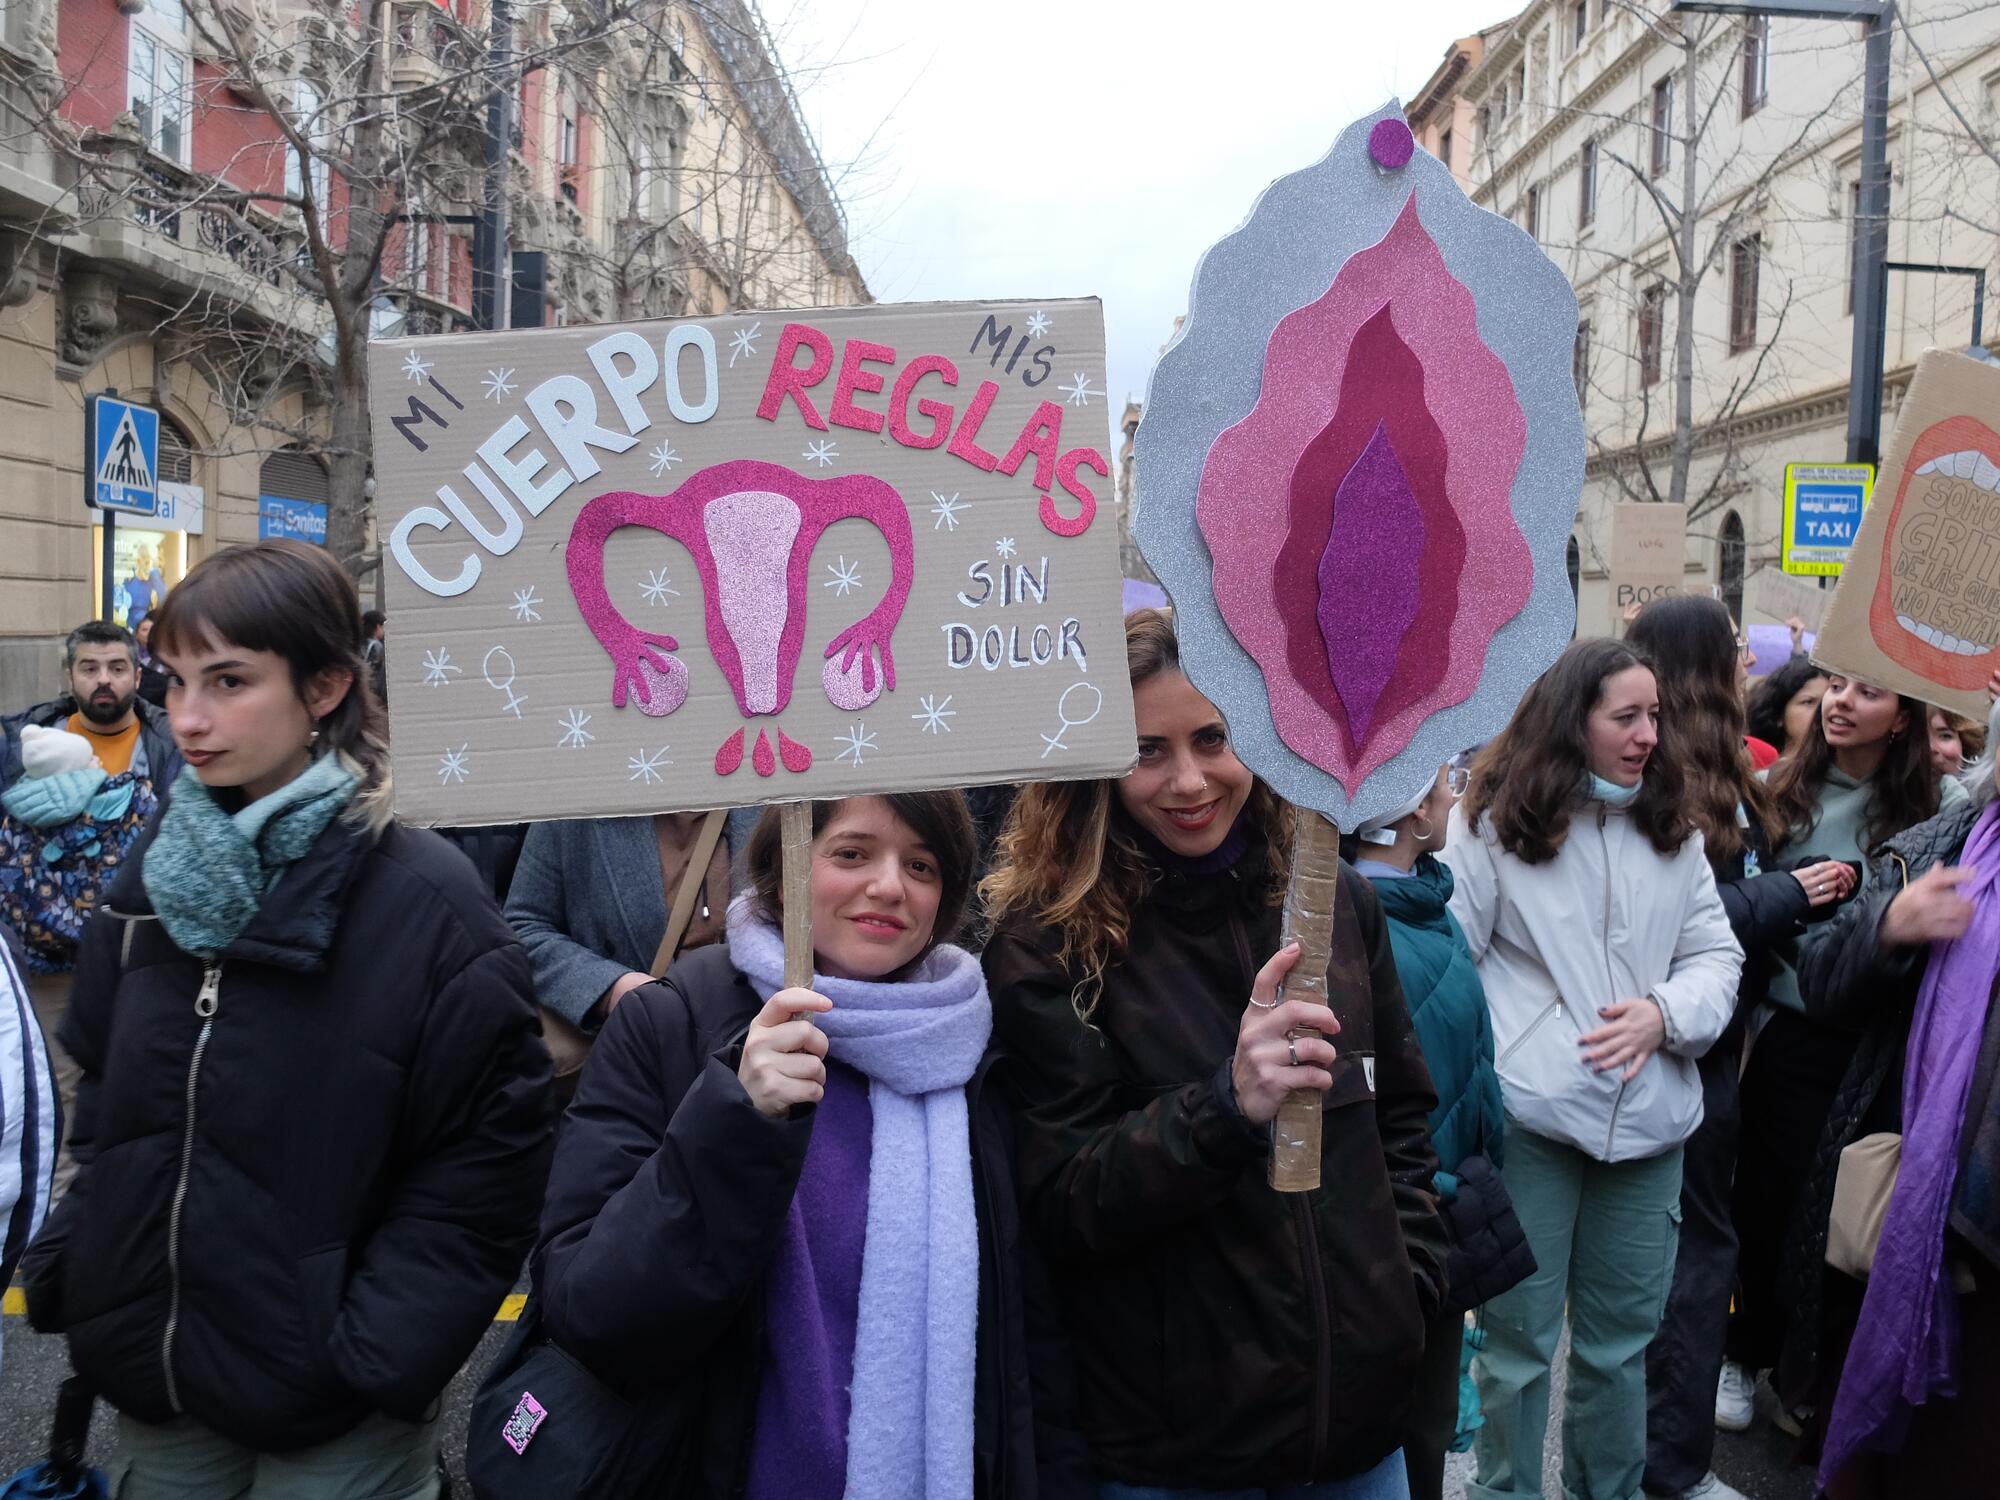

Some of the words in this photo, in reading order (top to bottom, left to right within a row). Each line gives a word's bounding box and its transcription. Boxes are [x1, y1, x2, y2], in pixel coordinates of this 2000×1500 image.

[970, 314, 1056, 388] MIS
[391, 375, 464, 453] MI
[756, 323, 1109, 537] REGLAS
[390, 324, 719, 597] CUERPO
[285, 509, 327, 534] Sanitas
[1805, 521, 1851, 538] TAXI
[1923, 477, 2000, 534] SOMO
[1893, 551, 1925, 582] DE
[1921, 562, 1964, 598] LAS
[1901, 511, 2000, 583] GRIT
[957, 556, 1049, 608] SIN
[1893, 583, 1929, 618] NO
[941, 617, 1087, 673] DOLOR
